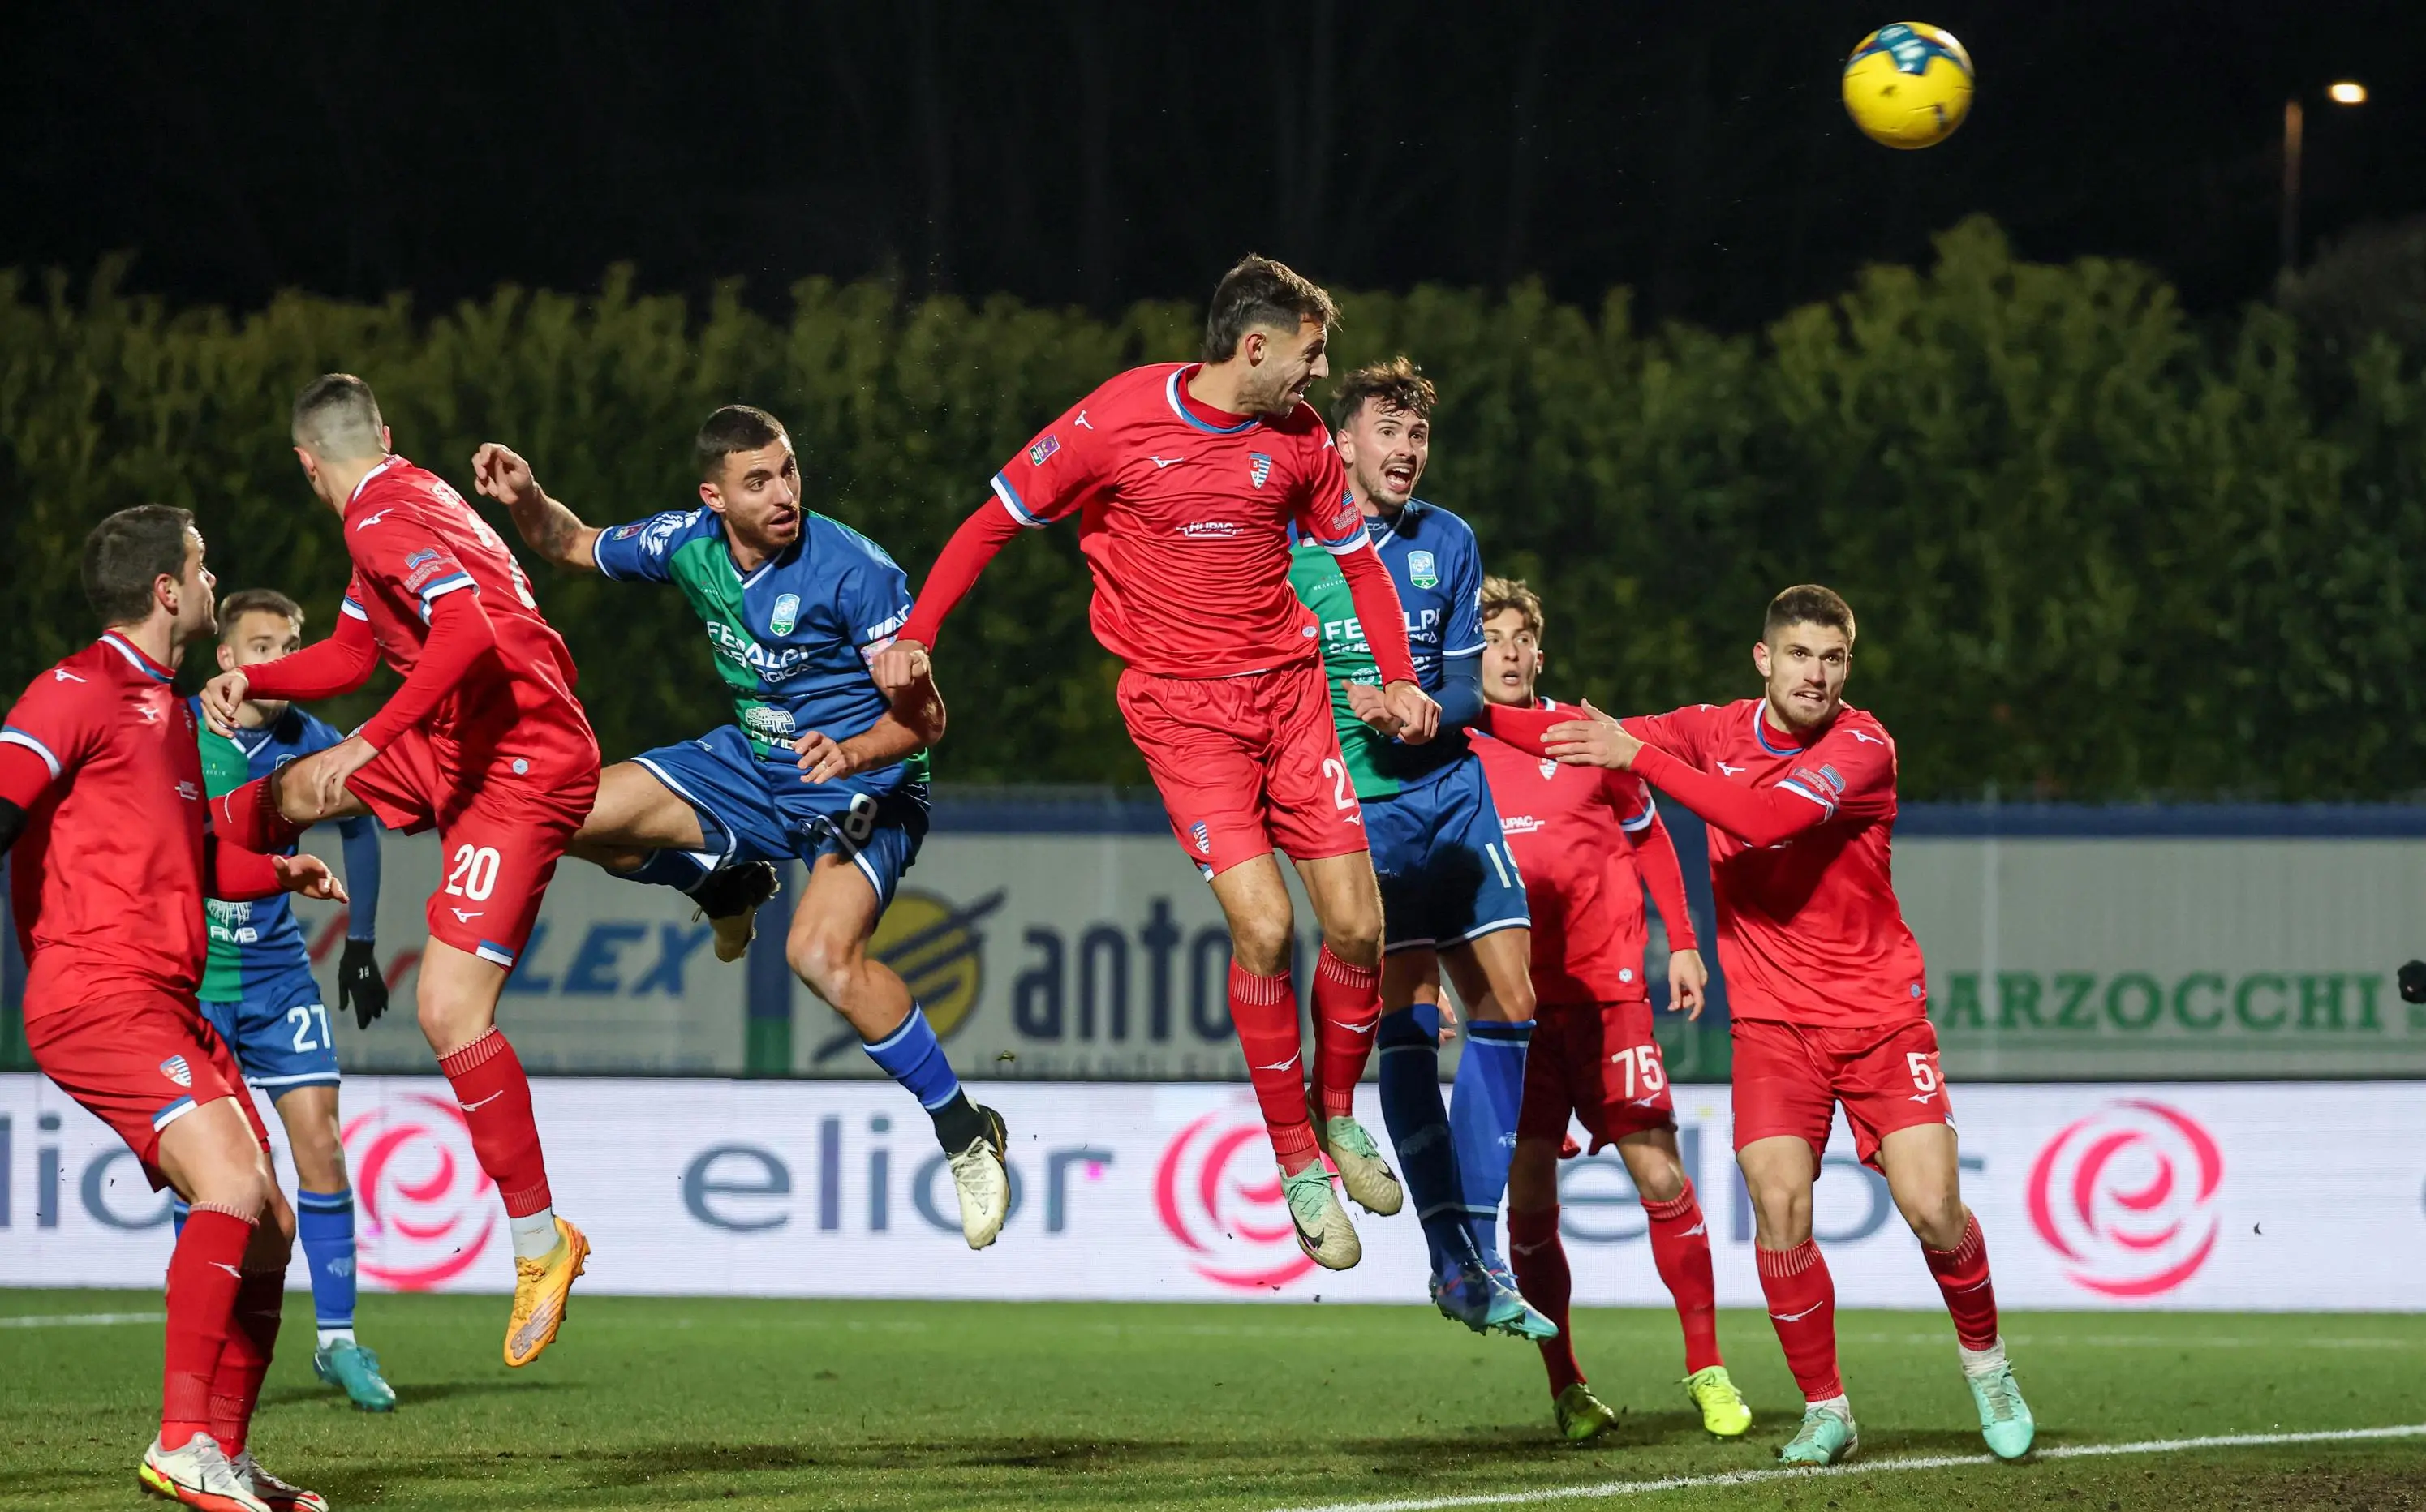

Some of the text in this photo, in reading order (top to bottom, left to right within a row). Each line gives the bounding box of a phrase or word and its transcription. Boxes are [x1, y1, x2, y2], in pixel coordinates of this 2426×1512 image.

[1324, 608, 1440, 641] FELPI
[1322, 756, 1360, 810] 2
[844, 793, 878, 840] 8
[1500, 815, 1534, 829] UPAC
[444, 844, 501, 901] 20
[509, 920, 715, 998] LEX
[1925, 971, 2385, 1030] ARZOCCHI
[1611, 1045, 1665, 1098] 75
[1906, 1052, 1937, 1093] 5
[0, 1116, 174, 1230] lio
